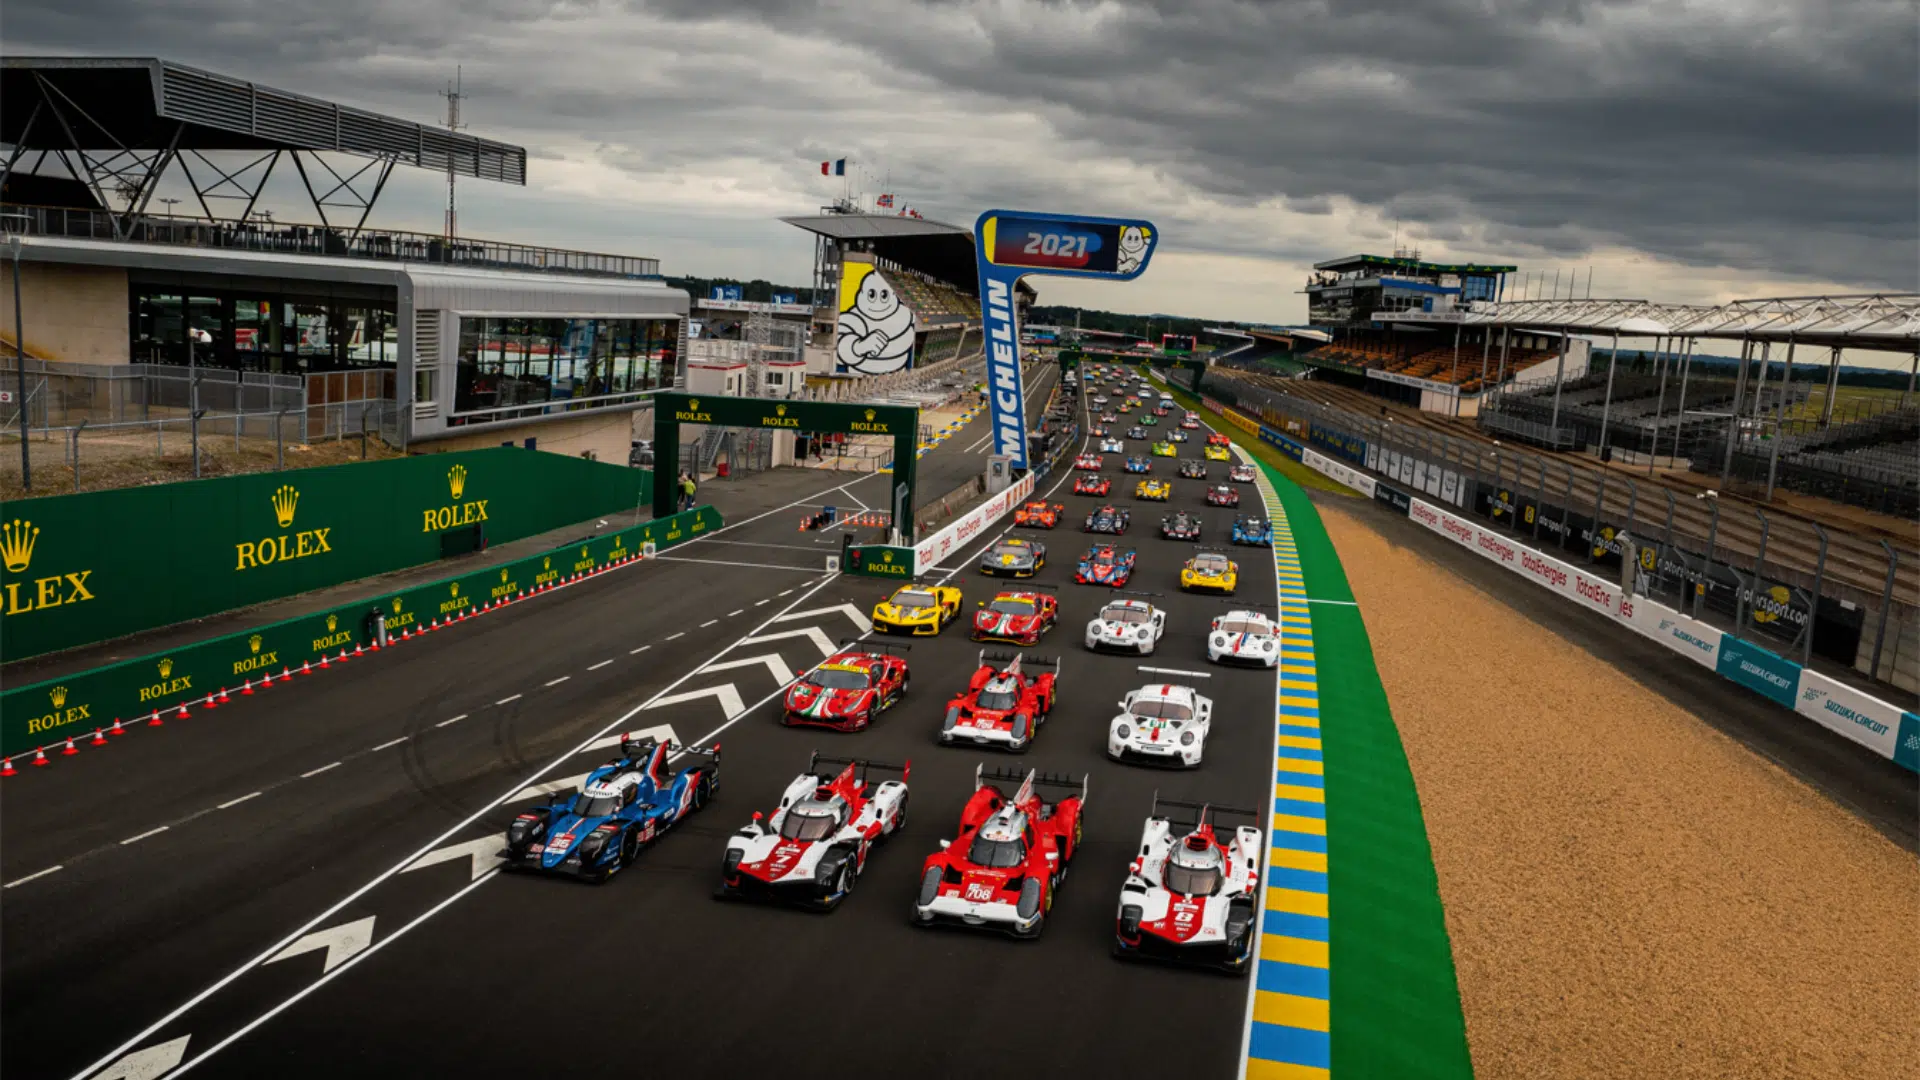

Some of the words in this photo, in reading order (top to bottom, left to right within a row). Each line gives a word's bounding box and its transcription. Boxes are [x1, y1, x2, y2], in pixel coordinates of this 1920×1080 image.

[1024, 232, 1088, 258] 2021
[987, 278, 1022, 463] MICHELIN
[675, 411, 711, 422] ROLEX
[762, 416, 799, 428] ROLEX
[851, 422, 889, 433] ROLEX
[422, 500, 489, 533] ROLEX
[235, 527, 332, 571] ROLEX
[1477, 532, 1515, 563] TotalEnergies
[536, 570, 558, 584] ROLEX
[868, 563, 906, 575] ROLEX
[1521, 551, 1568, 587] TotalEnergies
[0, 571, 94, 616] LEX
[491, 582, 517, 597] ROLEX
[440, 597, 469, 613] ROLEX
[313, 630, 351, 651] ROLEX
[233, 652, 278, 675] ROLEX
[1740, 660, 1765, 677] SUZUKA
[1765, 670, 1792, 690] CIRCUIT
[139, 675, 192, 702] ROLEX
[27, 704, 91, 734] ROLEX
[1824, 699, 1855, 721] SUZUKA
[1855, 713, 1889, 736] CIRCUIT
[776, 854, 792, 863] 7
[966, 889, 991, 900] 708
[1175, 912, 1194, 922] 8
